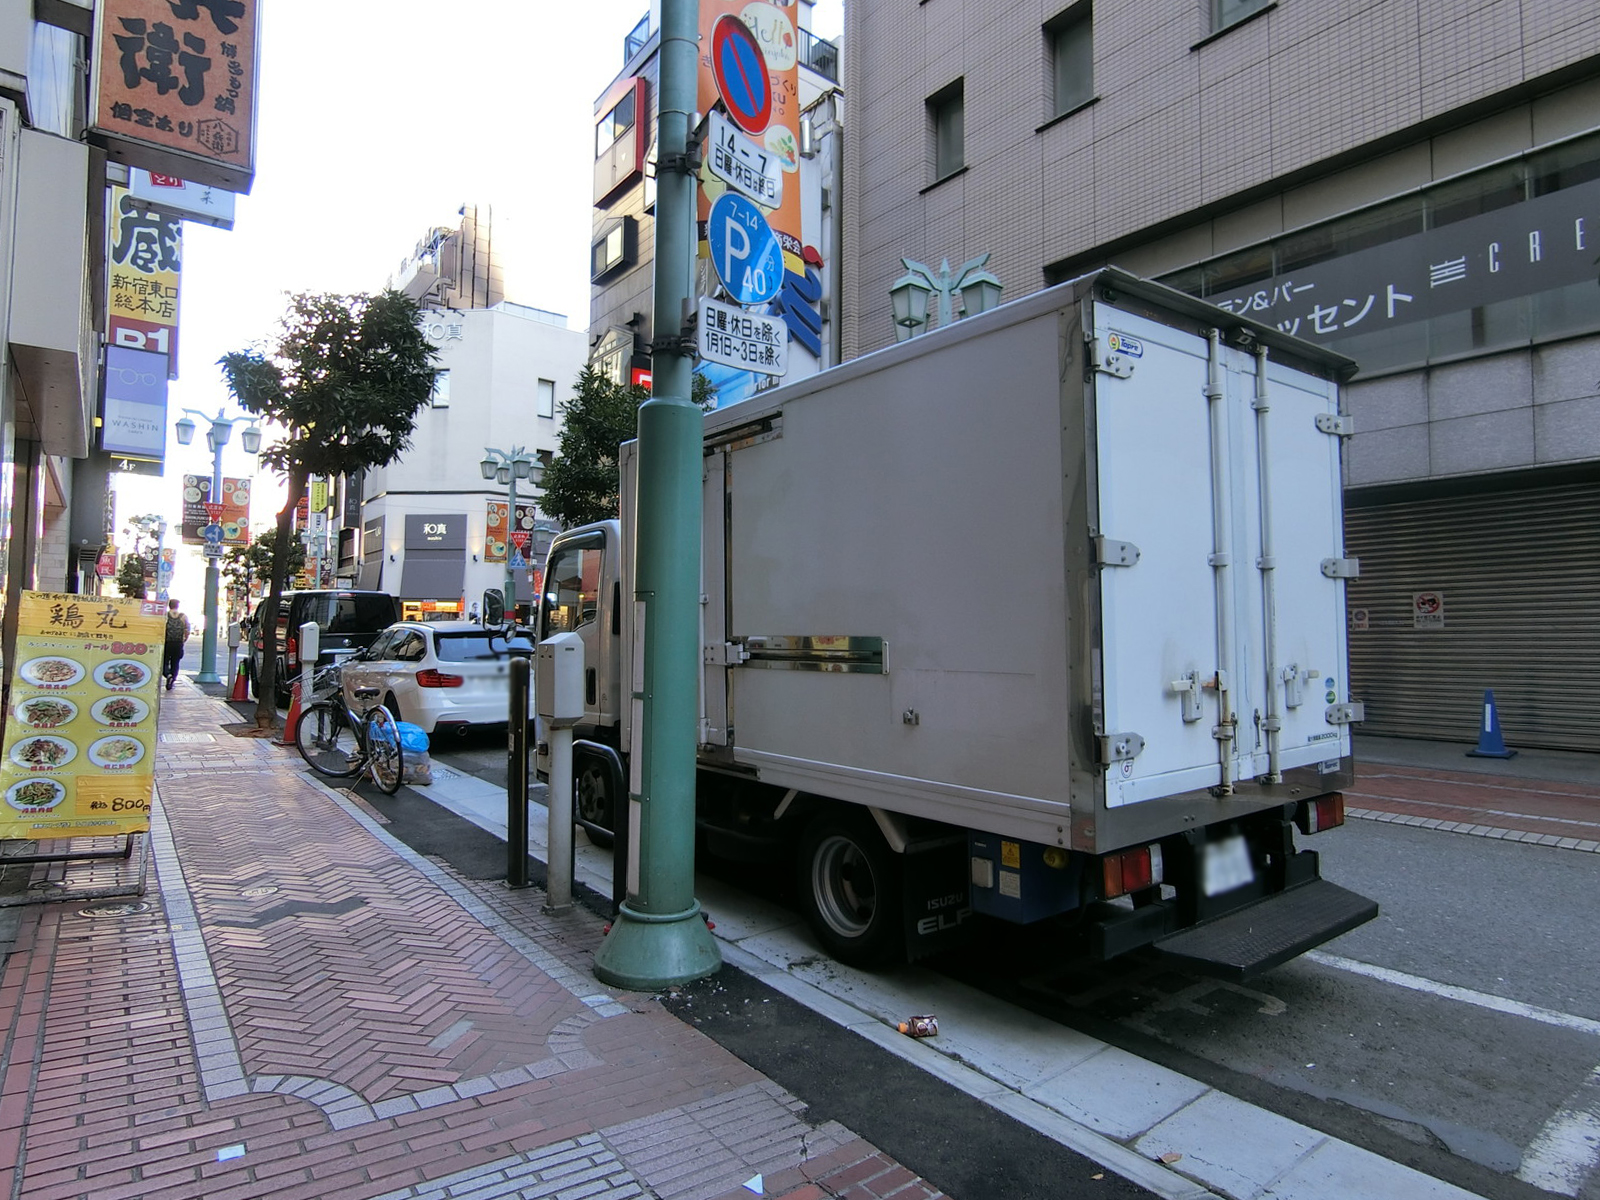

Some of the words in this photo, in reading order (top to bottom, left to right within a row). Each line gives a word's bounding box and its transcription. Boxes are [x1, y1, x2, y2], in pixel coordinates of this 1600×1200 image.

[725, 217, 750, 284] P
[112, 274, 178, 299] 新宿東口
[114, 293, 176, 318] 総本店
[112, 419, 159, 432] WASHIN
[119, 459, 136, 471] 4F
[423, 523, 447, 535] 和真
[143, 602, 165, 616] 2F
[926, 892, 964, 911] ISUZU
